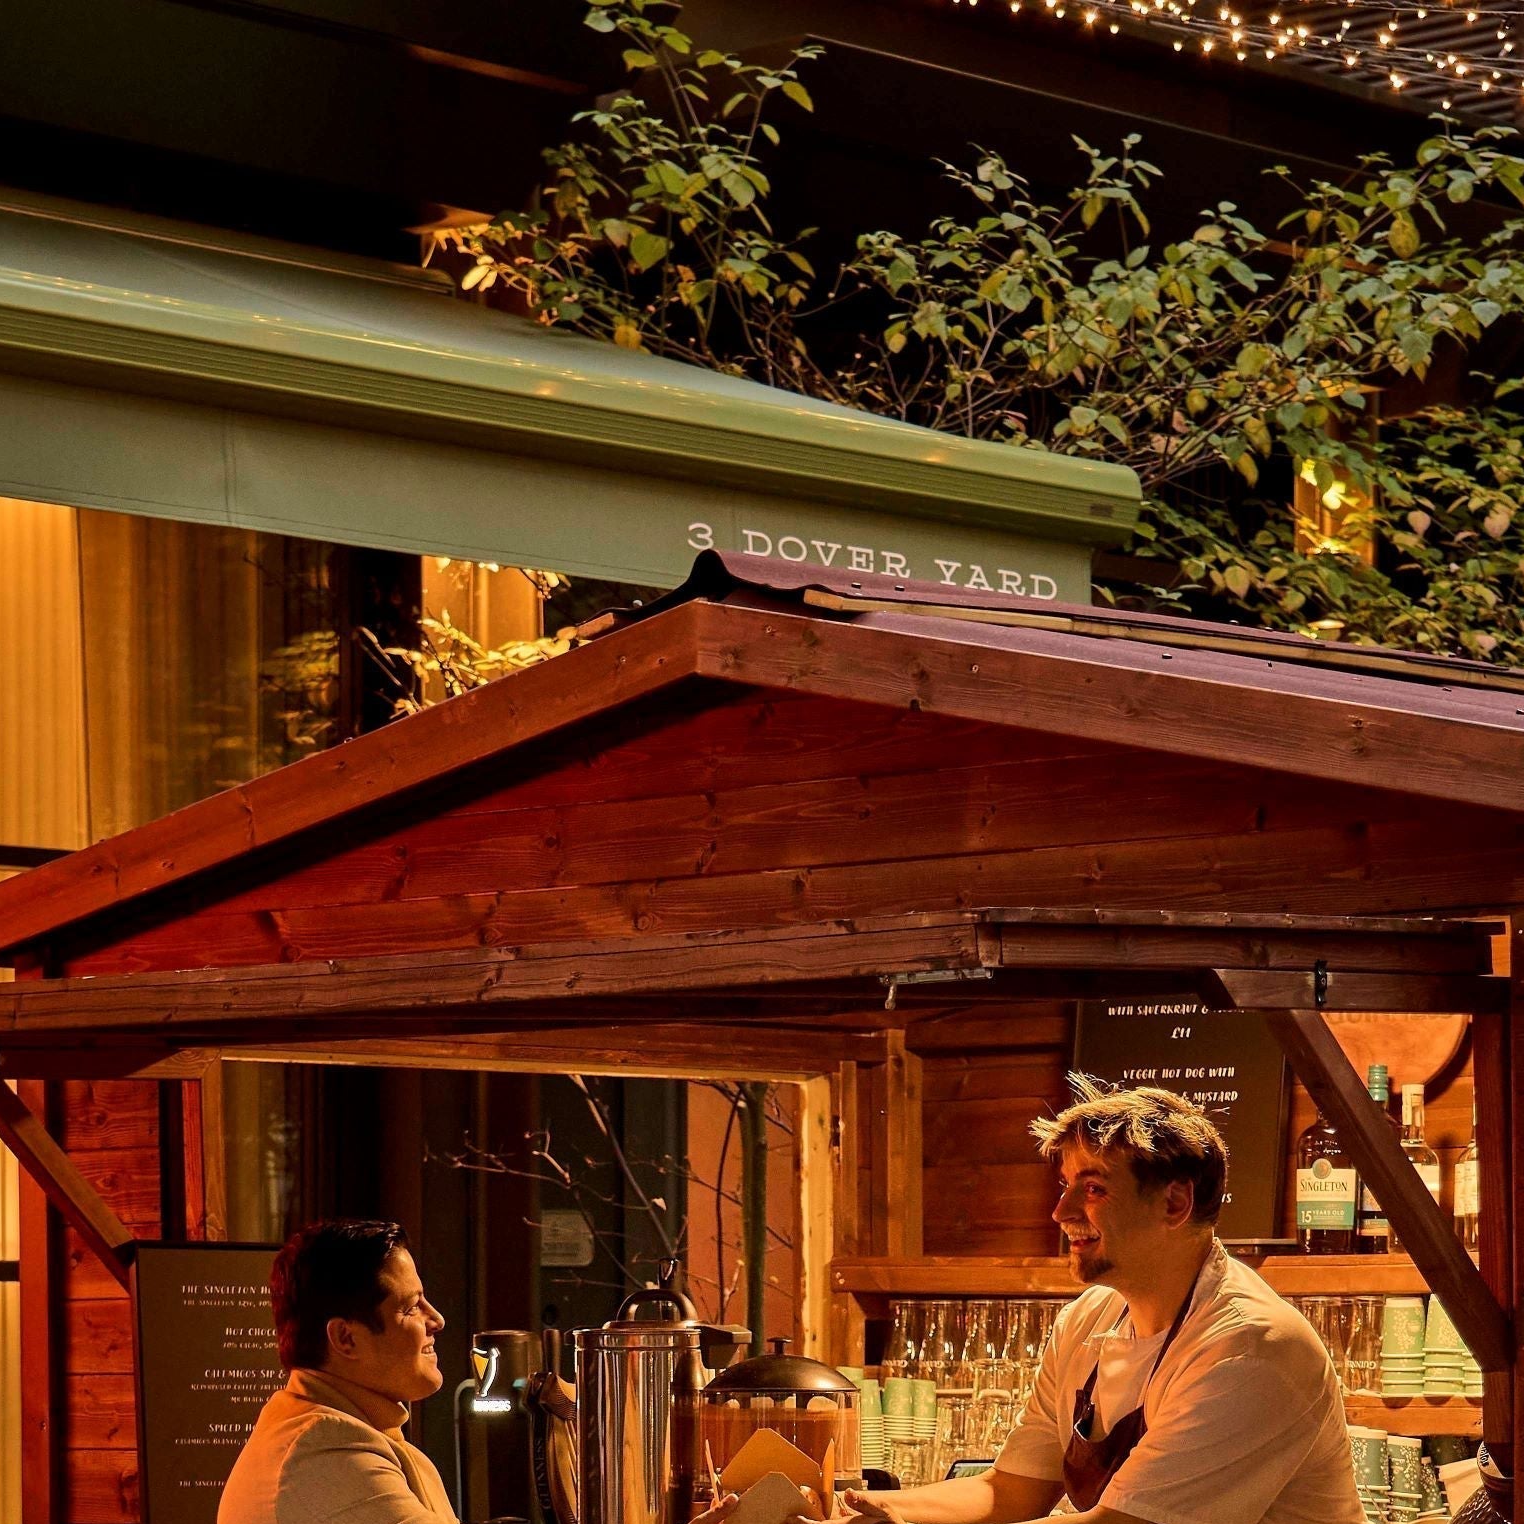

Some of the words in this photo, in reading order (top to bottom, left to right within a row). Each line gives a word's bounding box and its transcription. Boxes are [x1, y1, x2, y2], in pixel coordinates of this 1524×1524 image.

[687, 522, 715, 550] 3
[742, 529, 911, 579] DOVER
[933, 558, 1059, 601] YARD
[1108, 1005, 1133, 1016] WITH
[1137, 1003, 1198, 1017] SAUERKRAUT
[1171, 1026, 1191, 1039] £11
[1123, 1068, 1158, 1080] VEGGIE
[1161, 1068, 1182, 1079] HOT
[1185, 1067, 1205, 1079] DOG
[1208, 1066, 1235, 1078] WITH
[1193, 1091, 1238, 1102] MUSTARD
[1300, 1178, 1348, 1192] SINGLETON
[1301, 1210, 1312, 1223] 15
[182, 1285, 198, 1294] THE
[204, 1285, 256, 1295] SINGLETON
[225, 1327, 244, 1336] HOT
[209, 1423, 241, 1432] SPICED
